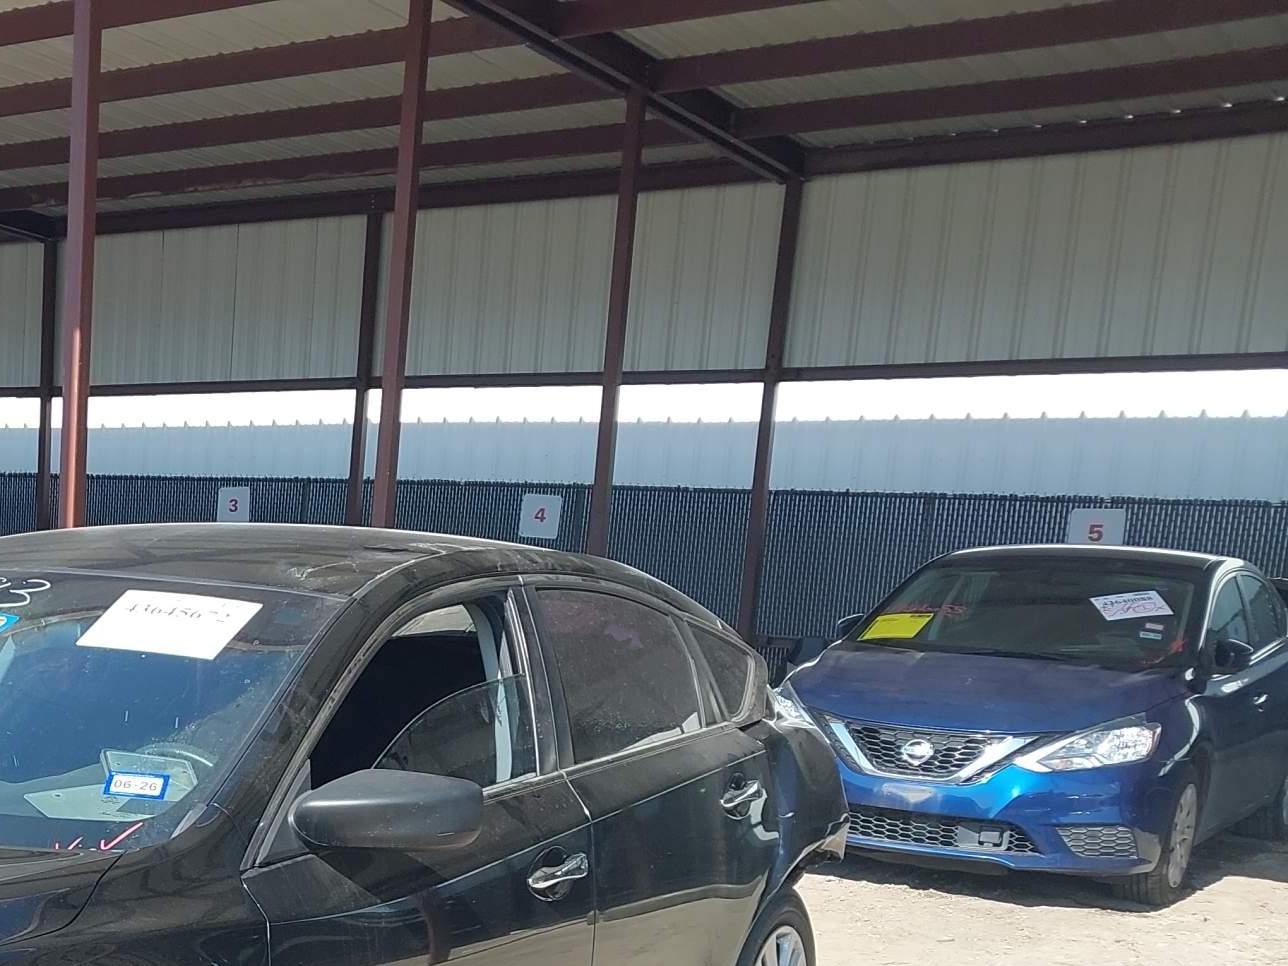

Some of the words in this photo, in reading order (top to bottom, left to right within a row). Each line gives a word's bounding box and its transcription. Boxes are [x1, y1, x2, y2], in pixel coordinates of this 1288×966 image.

[229, 499, 238, 512] 3
[534, 508, 546, 522] 4
[1088, 525, 1103, 541] 5
